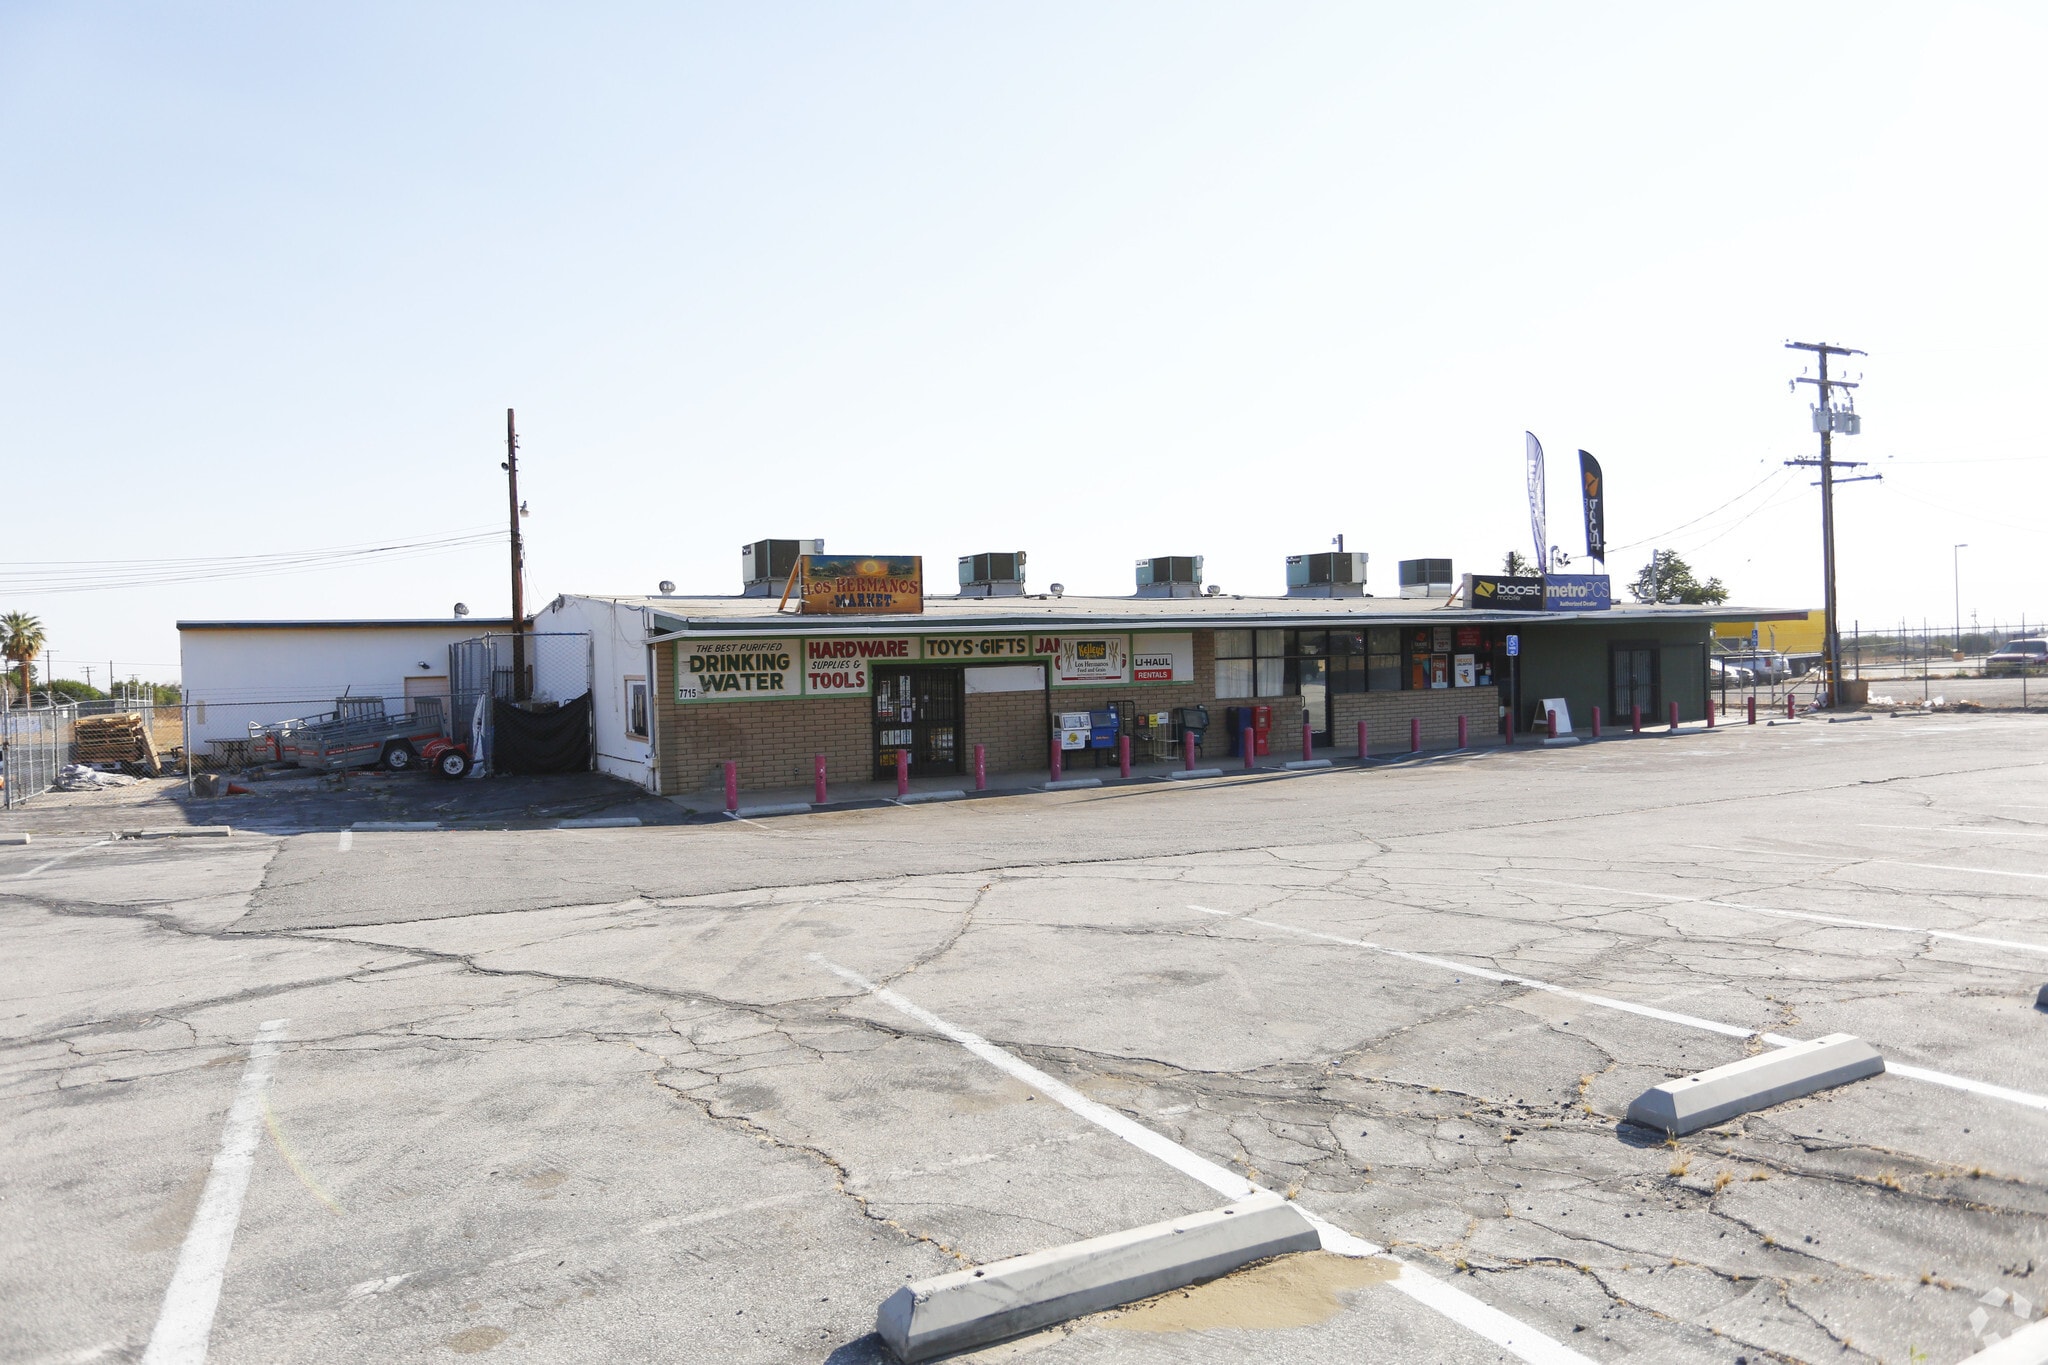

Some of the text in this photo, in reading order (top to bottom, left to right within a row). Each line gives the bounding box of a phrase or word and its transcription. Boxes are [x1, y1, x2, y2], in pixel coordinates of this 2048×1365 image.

[1590, 498, 1601, 551] boost
[804, 577, 918, 596] LOS HERMANOS
[1497, 583, 1540, 596] boost
[1546, 582, 1609, 598] metroPCS
[834, 594, 892, 608] MARKET
[696, 643, 783, 653] THE BEST PURIFIED
[809, 640, 909, 659] HARDWARE
[689, 653, 791, 673] DRINKING
[812, 660, 862, 670] SUPPLIES &
[1135, 658, 1170, 666] U-HAUL
[698, 673, 784, 692] WATER
[808, 671, 865, 690] TOOLS
[1138, 671, 1168, 679] RENTALS
[679, 689, 696, 698] 7715
